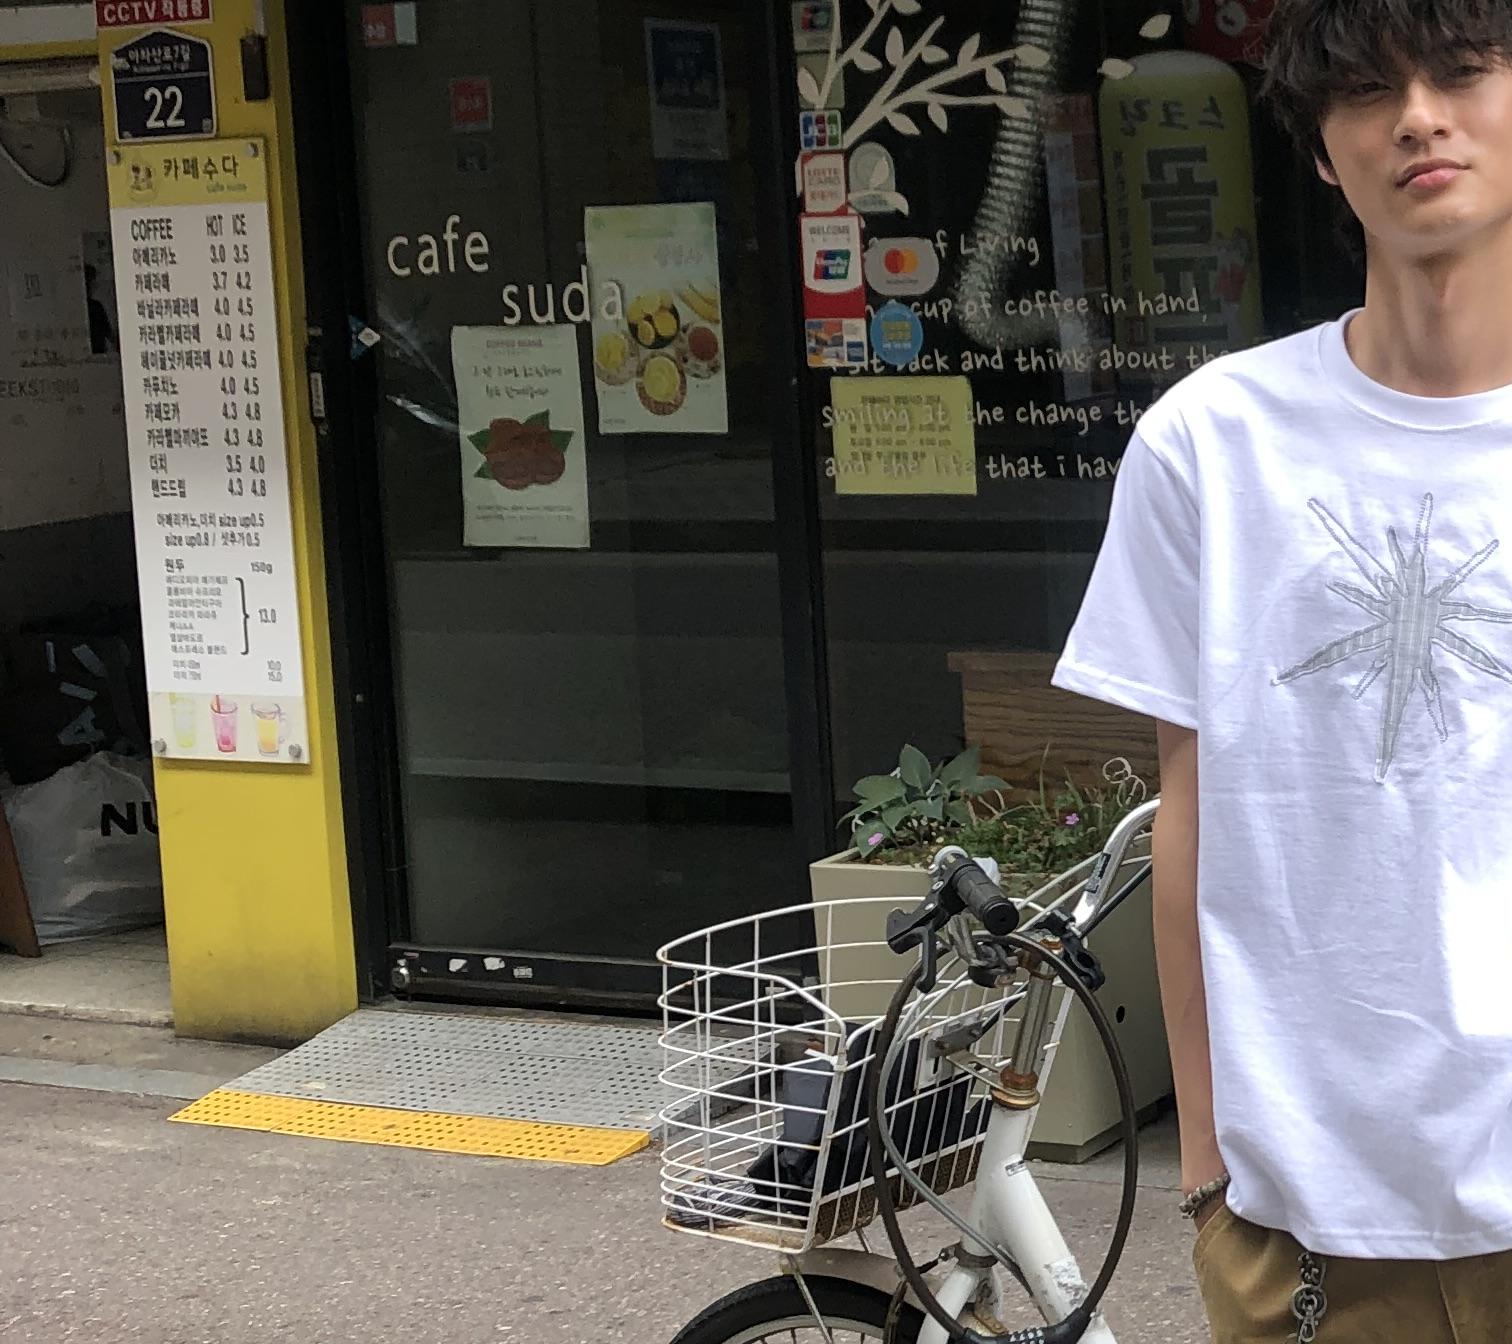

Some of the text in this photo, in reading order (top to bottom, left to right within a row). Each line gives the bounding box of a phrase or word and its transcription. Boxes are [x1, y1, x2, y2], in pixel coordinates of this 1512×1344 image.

[143, 85, 186, 130] 22
[163, 155, 239, 181] 카페수다
[131, 213, 248, 242] COFFEE HOT ICE
[209, 243, 226, 264] 3.0
[233, 243, 250, 264] 3.5
[387, 214, 490, 278] cafe
[960, 232, 1041, 268] Living
[212, 271, 228, 291] 3.7
[236, 271, 252, 291] 4.2
[214, 296, 230, 316] 4.0
[237, 296, 254, 316] 4.5
[501, 264, 623, 326] suda
[910, 297, 952, 324] cup
[1004, 290, 1089, 319] coffee
[1103, 292, 1127, 315] in
[216, 322, 232, 342] 4.0
[239, 322, 255, 342] 4.5
[218, 349, 234, 369] 4.0
[241, 349, 257, 369] 4.5
[896, 347, 951, 374] ack
[960, 344, 1004, 372] and
[1014, 346, 1088, 374] think
[1099, 342, 1176, 372] about
[220, 375, 236, 395] 4.0
[243, 375, 260, 395] 4.5
[222, 401, 238, 421] 4.3
[245, 401, 261, 421] 4.8
[1015, 400, 1103, 436] change
[224, 427, 240, 447] 4.3
[225, 454, 242, 473] 3.5
[249, 454, 265, 474] 4.0
[985, 453, 1047, 479] that
[1076, 453, 1123, 480] hav
[227, 477, 244, 497] 4.3
[250, 478, 267, 497] 4.8
